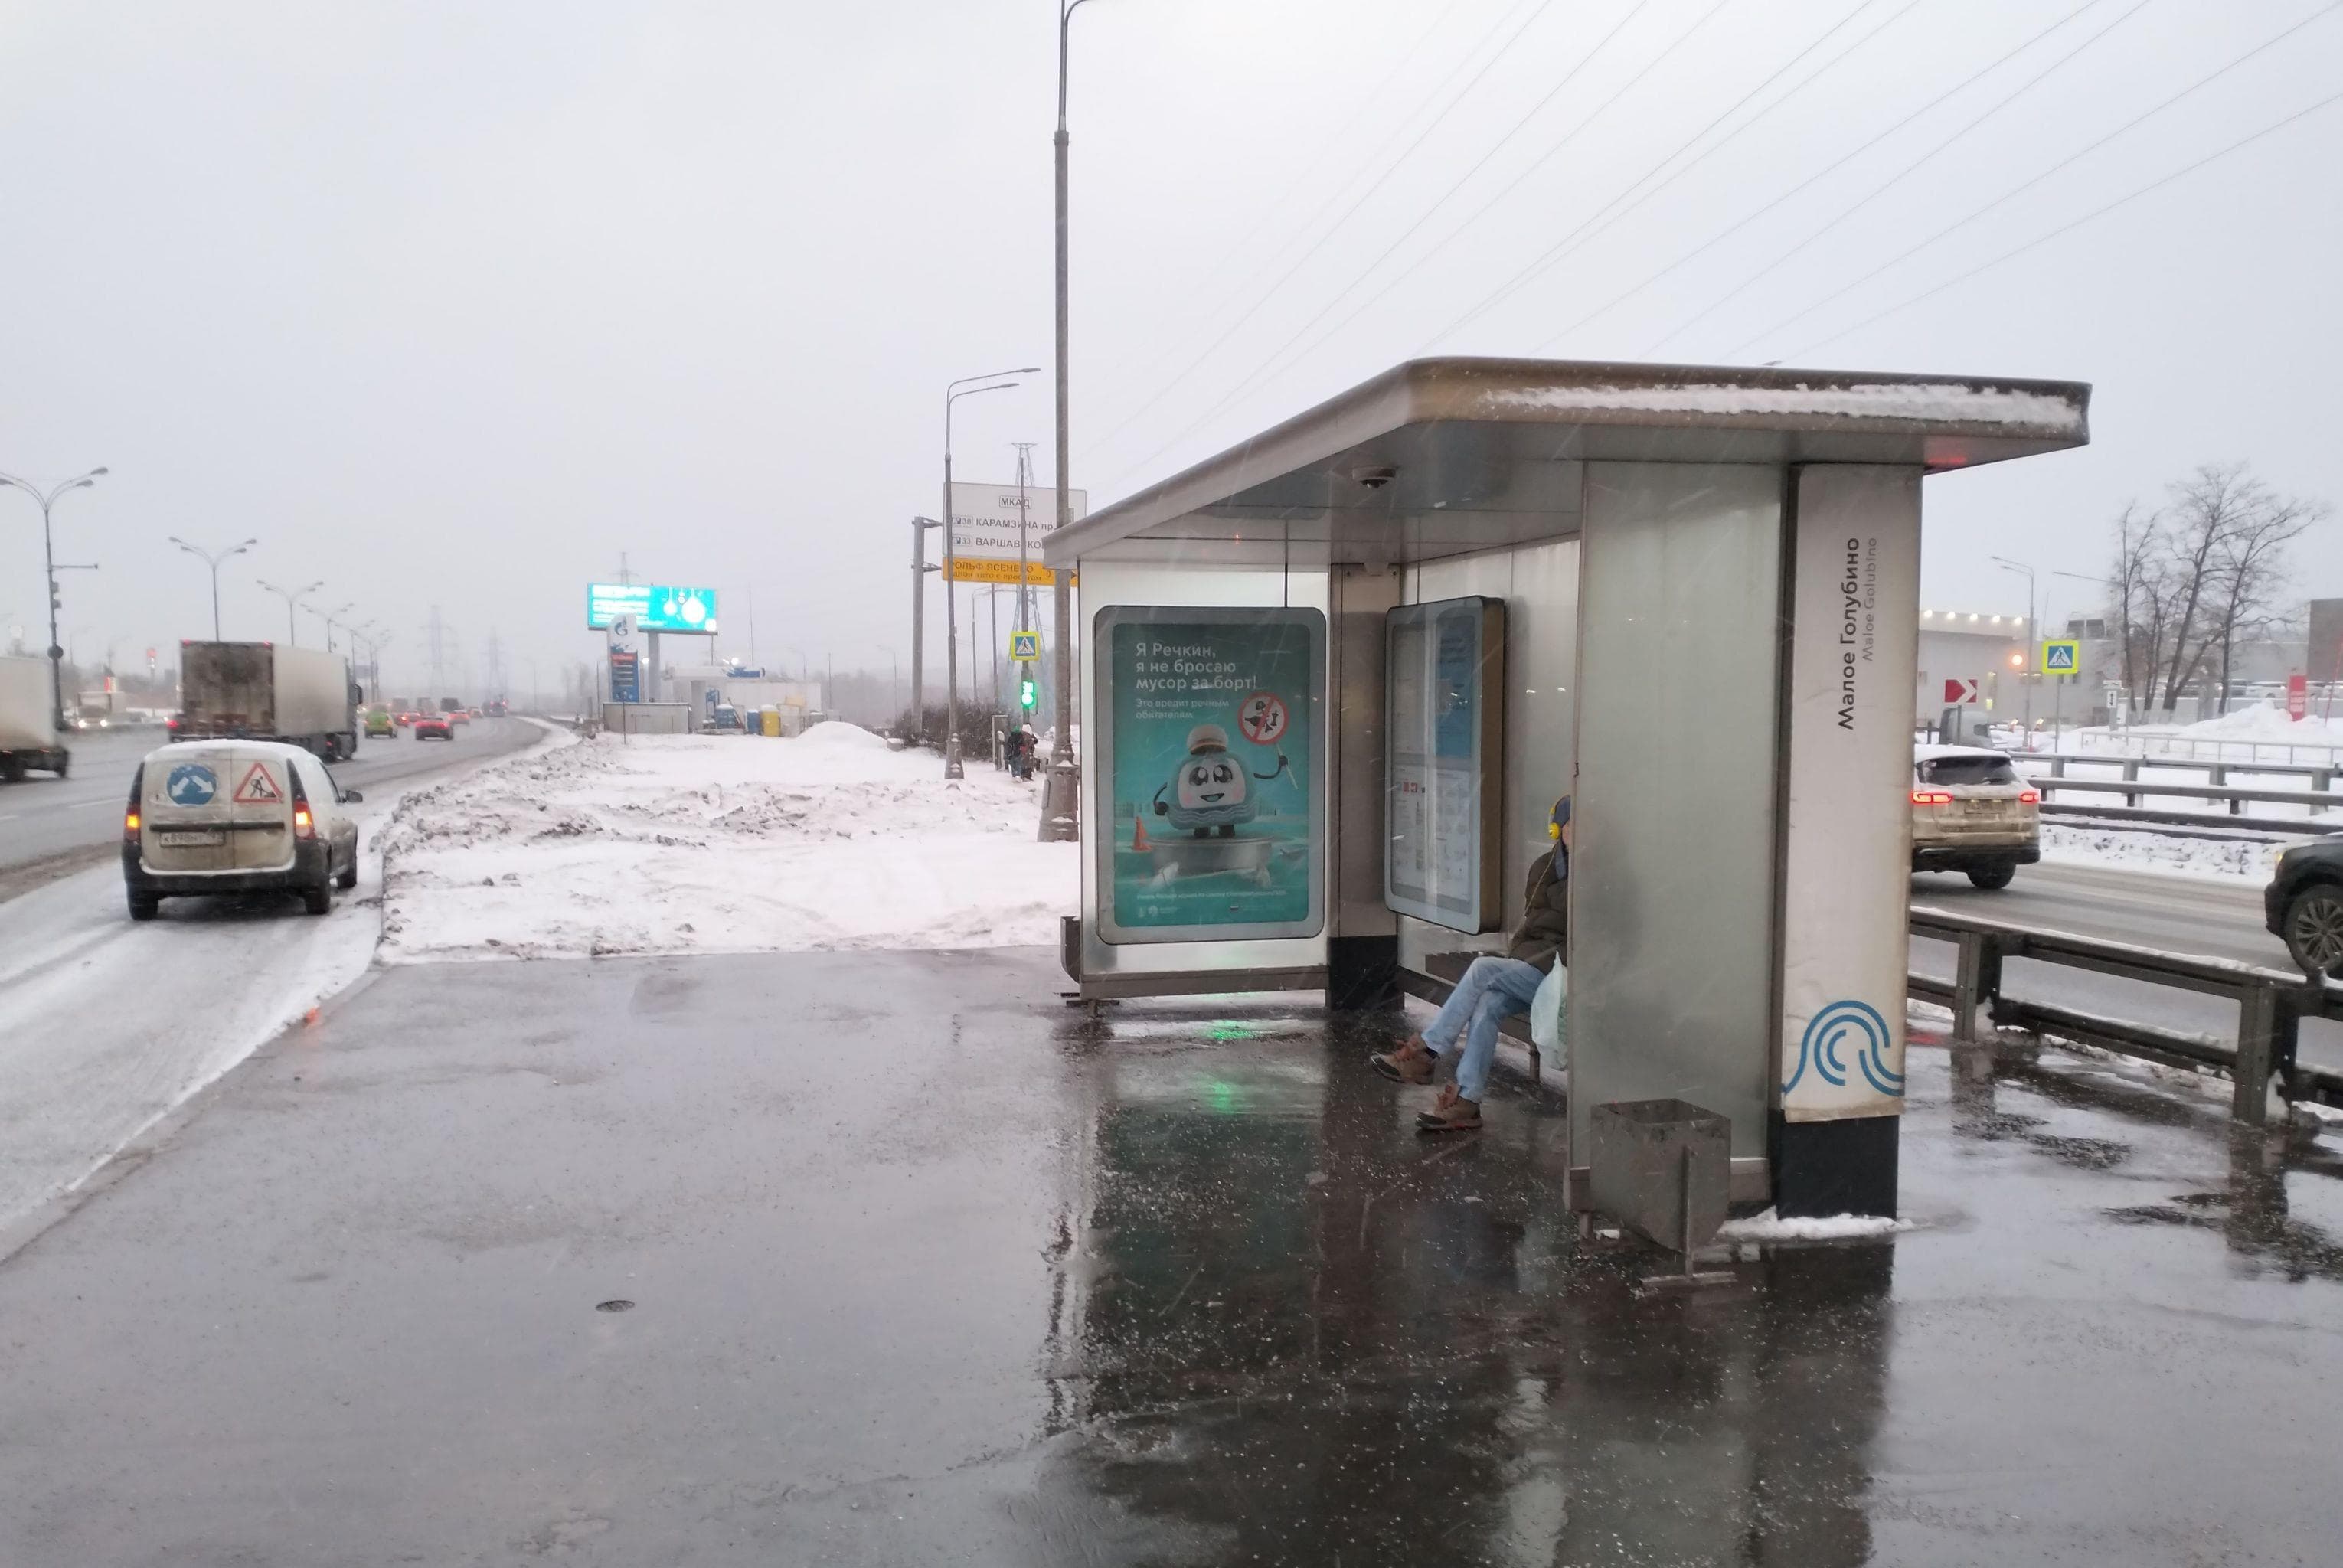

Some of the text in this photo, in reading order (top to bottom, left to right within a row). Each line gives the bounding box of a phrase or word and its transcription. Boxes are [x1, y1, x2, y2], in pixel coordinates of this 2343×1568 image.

[1001, 498, 1030, 508] МКАД
[975, 537, 1044, 549] ВАРШАВКО
[953, 562, 1034, 573] ОЛЬФ ЯСЕНЕО
[1862, 537, 1877, 662] Maloe Golubino
[1838, 537, 1861, 730] Малое Голубино
[1136, 642, 1217, 658] Я Речкин,
[1136, 660, 1237, 675] я не бросаю
[1136, 675, 1257, 692] мусор за борт!
[1136, 698, 1153, 708] Это
[1155, 700, 1188, 710] вредит
